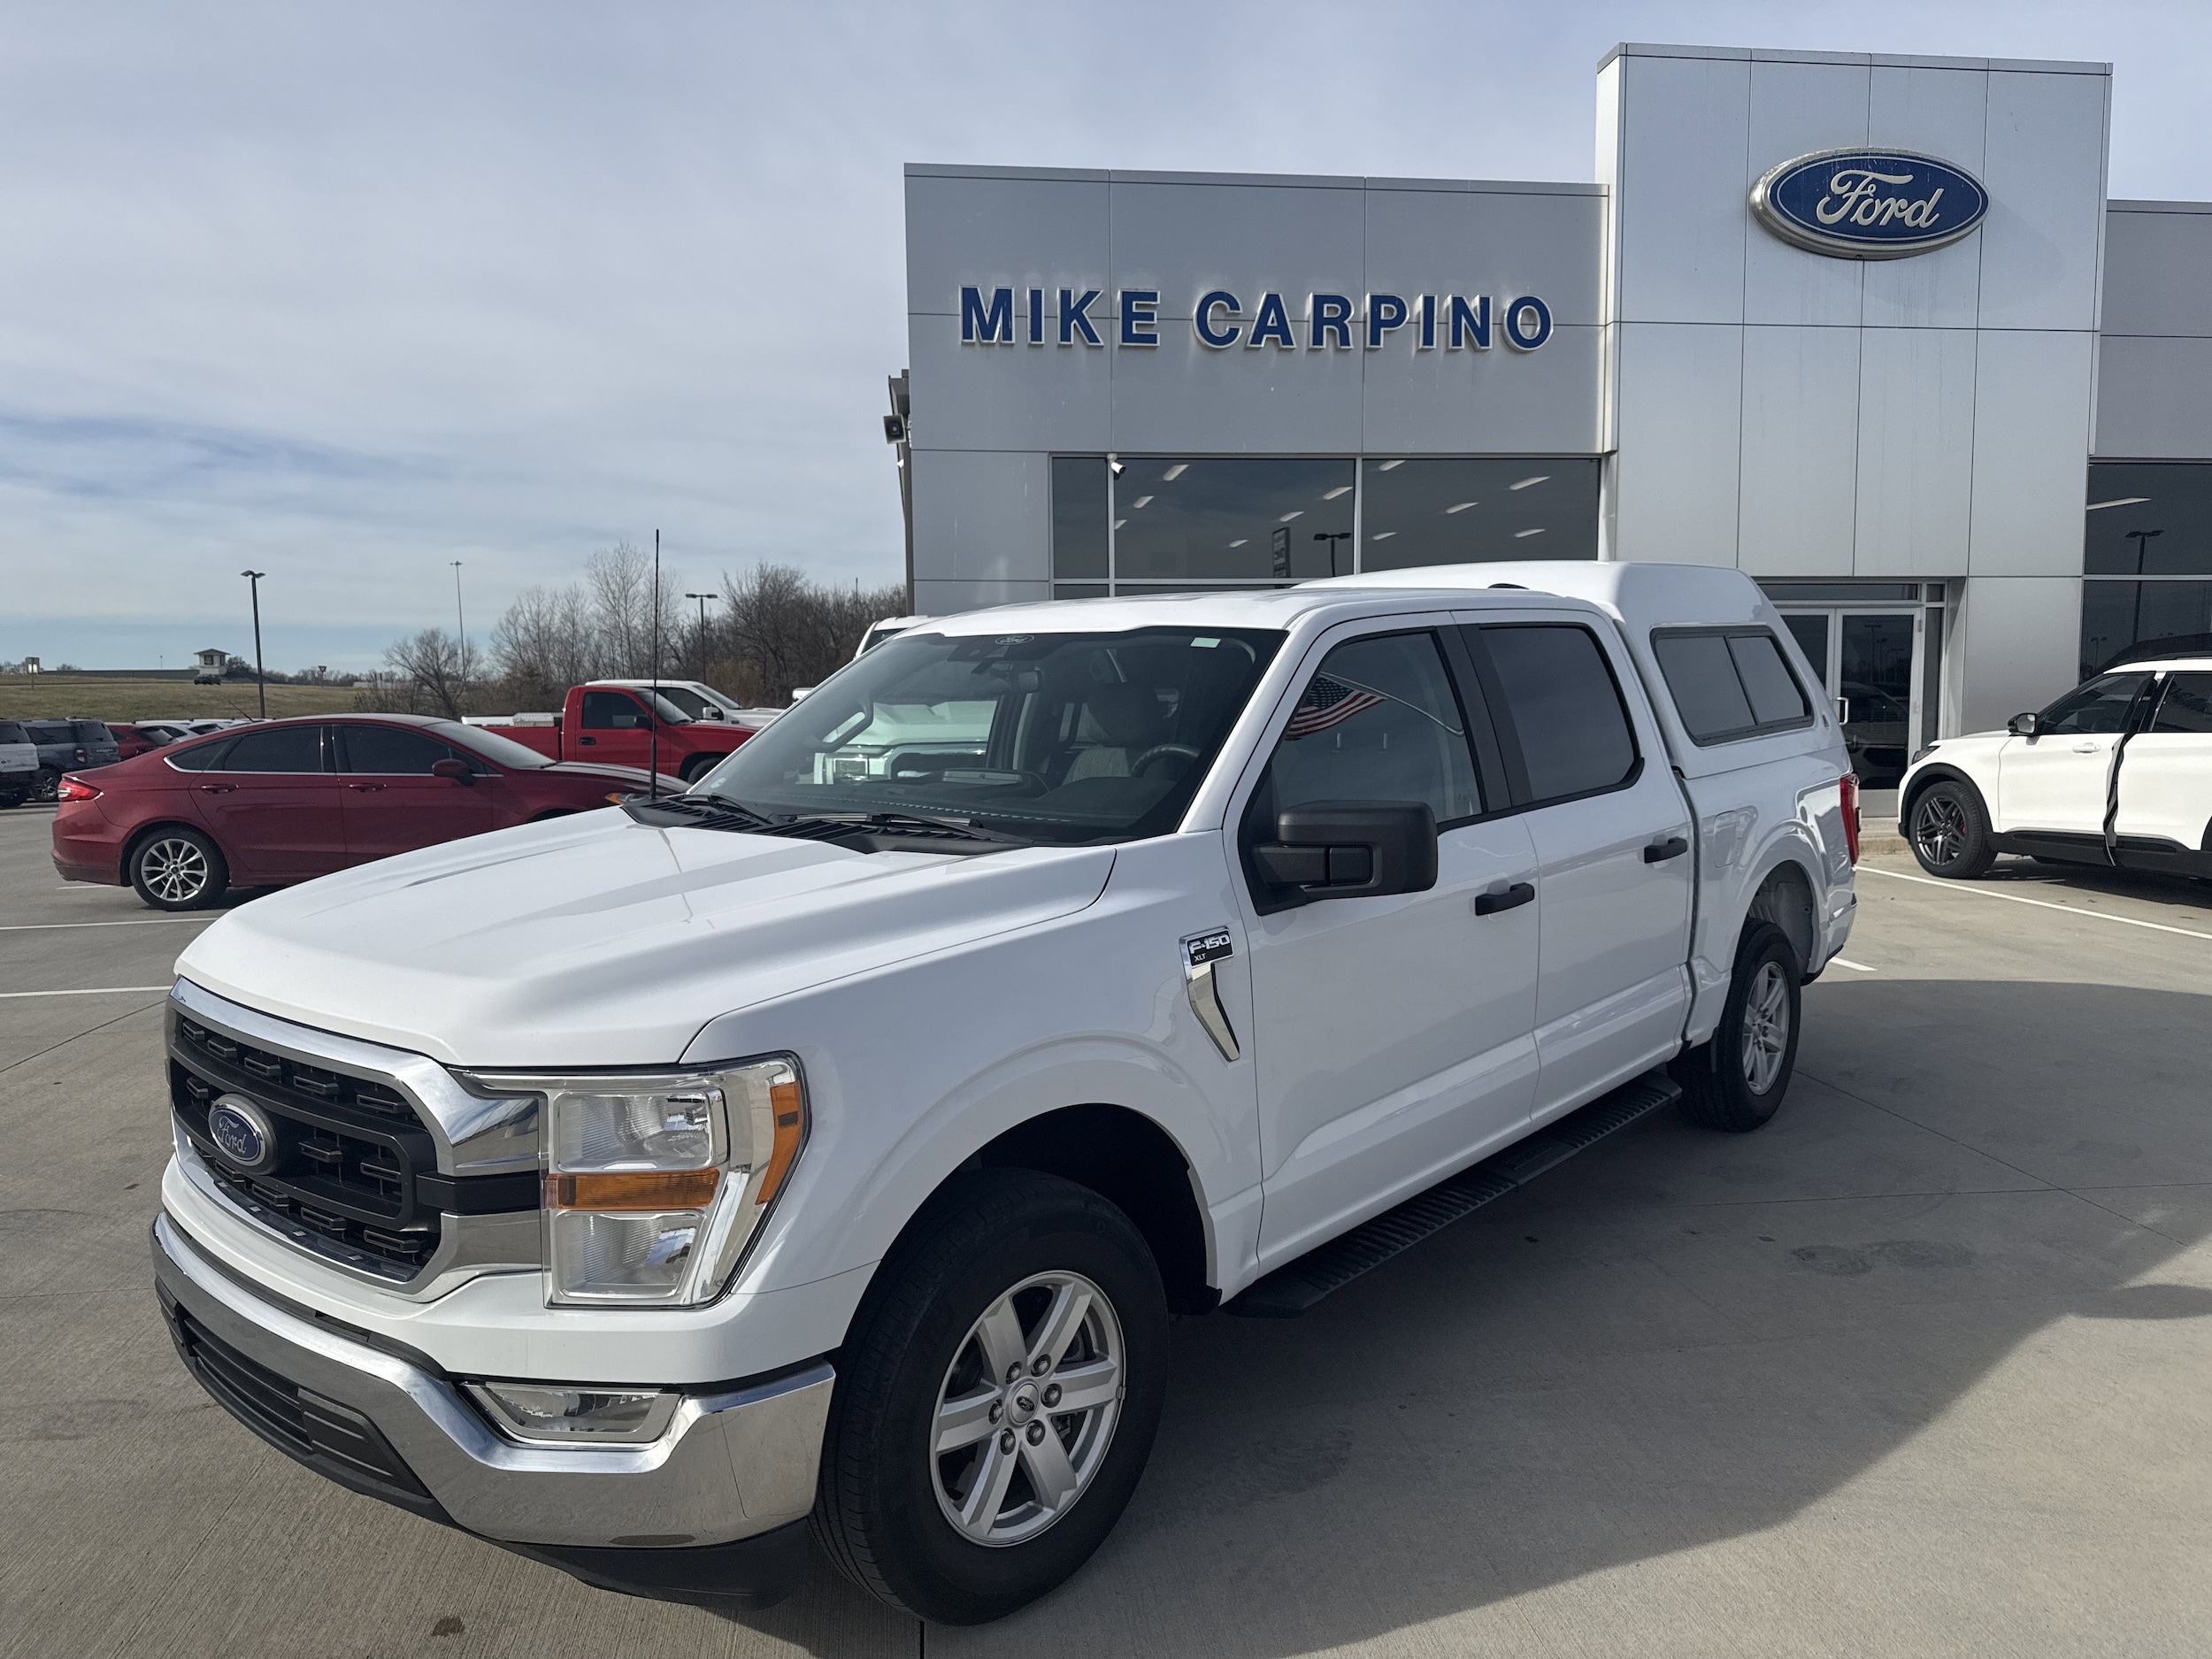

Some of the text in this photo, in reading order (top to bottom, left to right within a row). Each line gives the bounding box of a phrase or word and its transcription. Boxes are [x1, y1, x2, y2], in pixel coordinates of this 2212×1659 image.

[1816, 169, 1945, 228] Ford
[959, 285, 1554, 351] MIKE CARPINO
[1188, 934, 1231, 954] F-150
[1194, 953, 1206, 962] XLT
[217, 1116, 247, 1154] Ford
